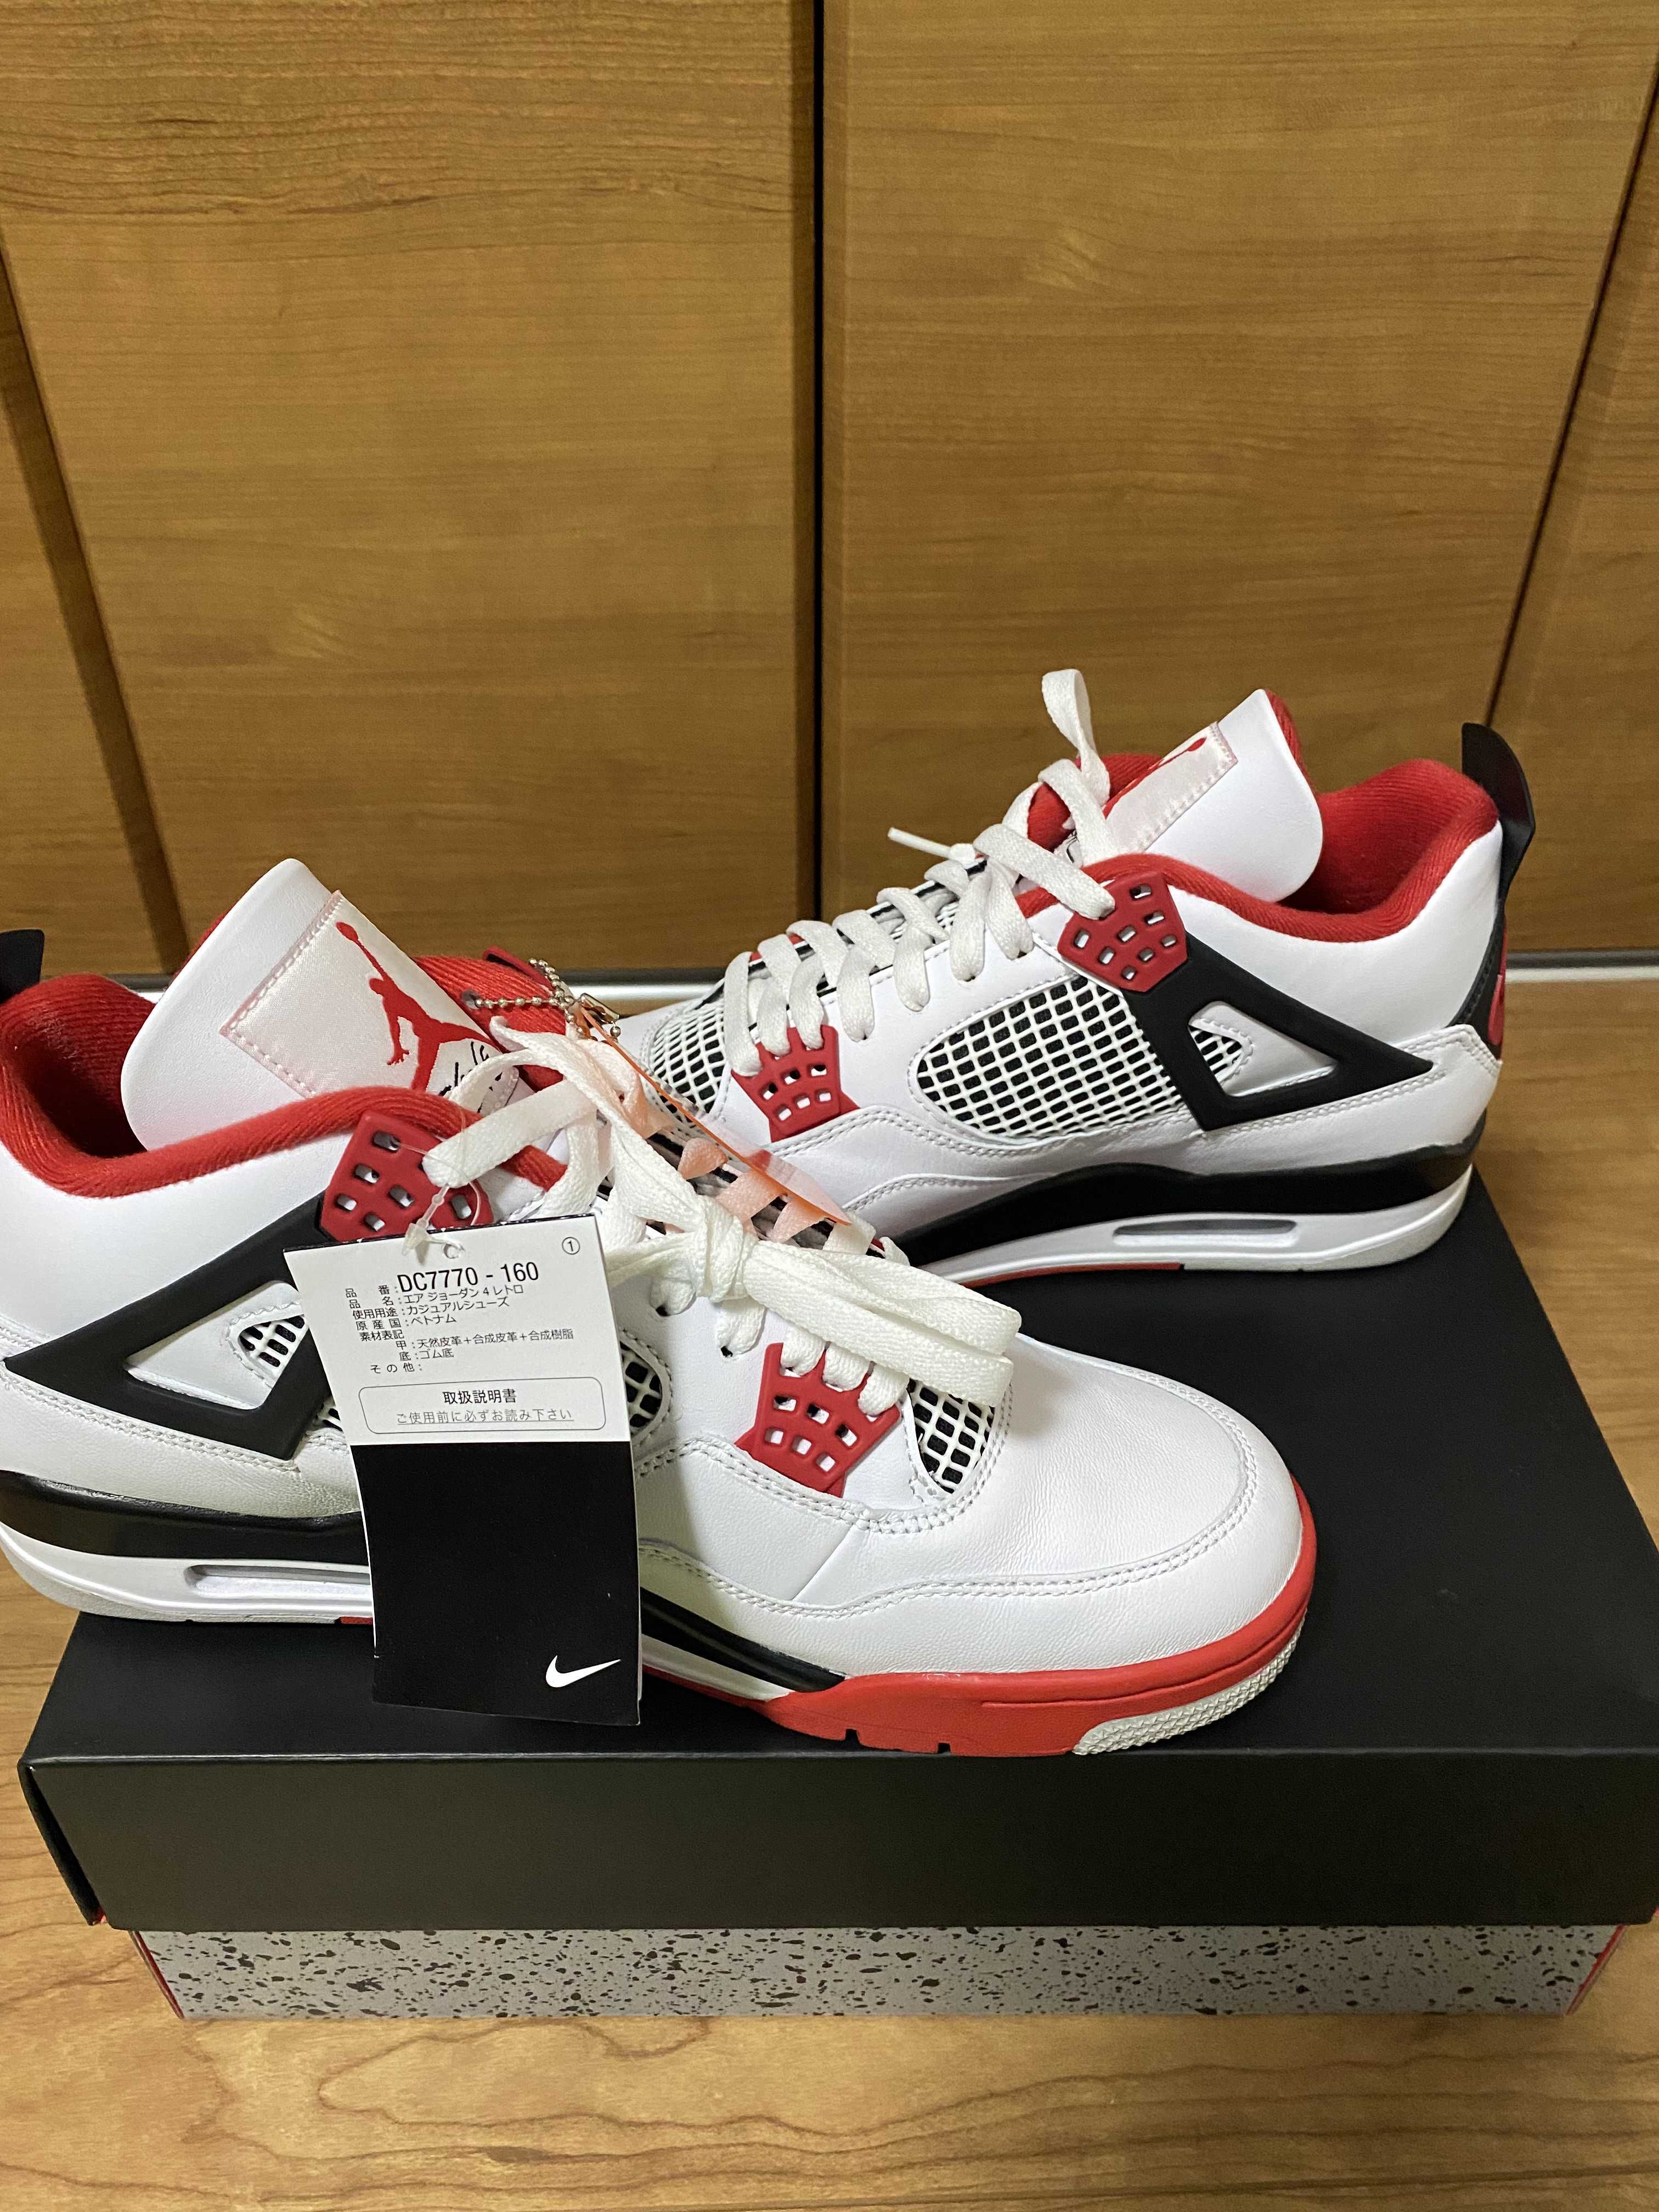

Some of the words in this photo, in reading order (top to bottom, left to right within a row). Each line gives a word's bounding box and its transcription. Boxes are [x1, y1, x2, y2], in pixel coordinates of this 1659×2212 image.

[397, 1267, 478, 1293] DC7770
[500, 1262, 539, 1282] 160
[359, 1329, 404, 1342] 素材表記
[442, 1389, 517, 1404] 取扱説明書
[397, 1408, 573, 1424] ご使用前に必ずお読み下さい
